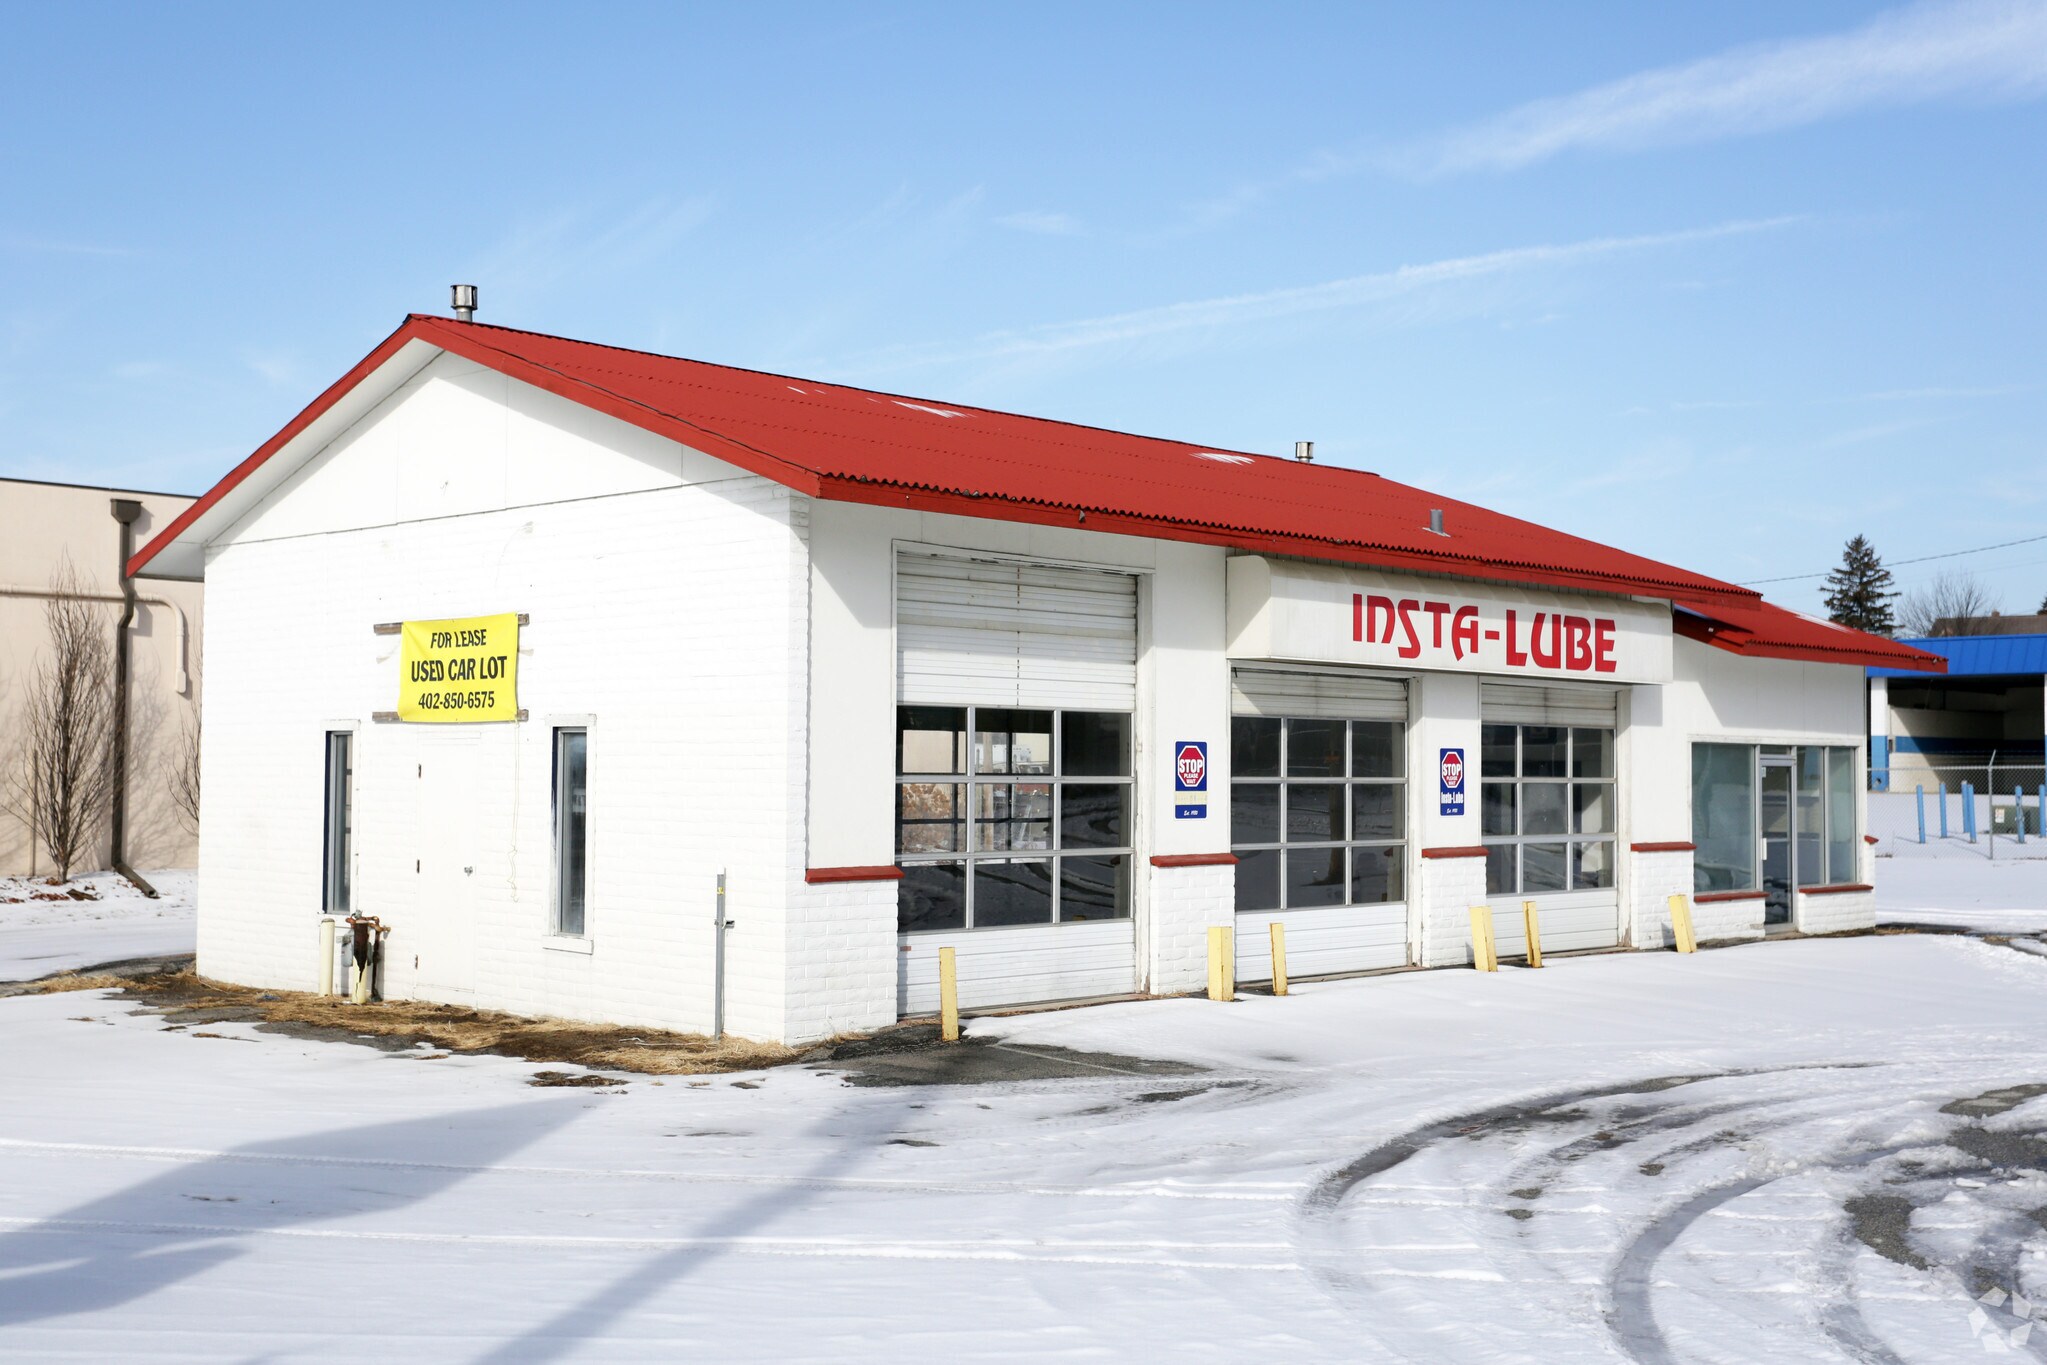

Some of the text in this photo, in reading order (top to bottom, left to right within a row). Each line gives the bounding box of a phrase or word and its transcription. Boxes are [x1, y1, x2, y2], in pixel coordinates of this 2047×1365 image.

[430, 629, 487, 649] FOR LEASE
[1353, 593, 1617, 673] INSTA-LUBE
[411, 656, 508, 682] USED CAR LOT
[418, 691, 495, 709] 402-850-6575
[1179, 759, 1203, 773] STOP
[1443, 764, 1461, 776] STOP
